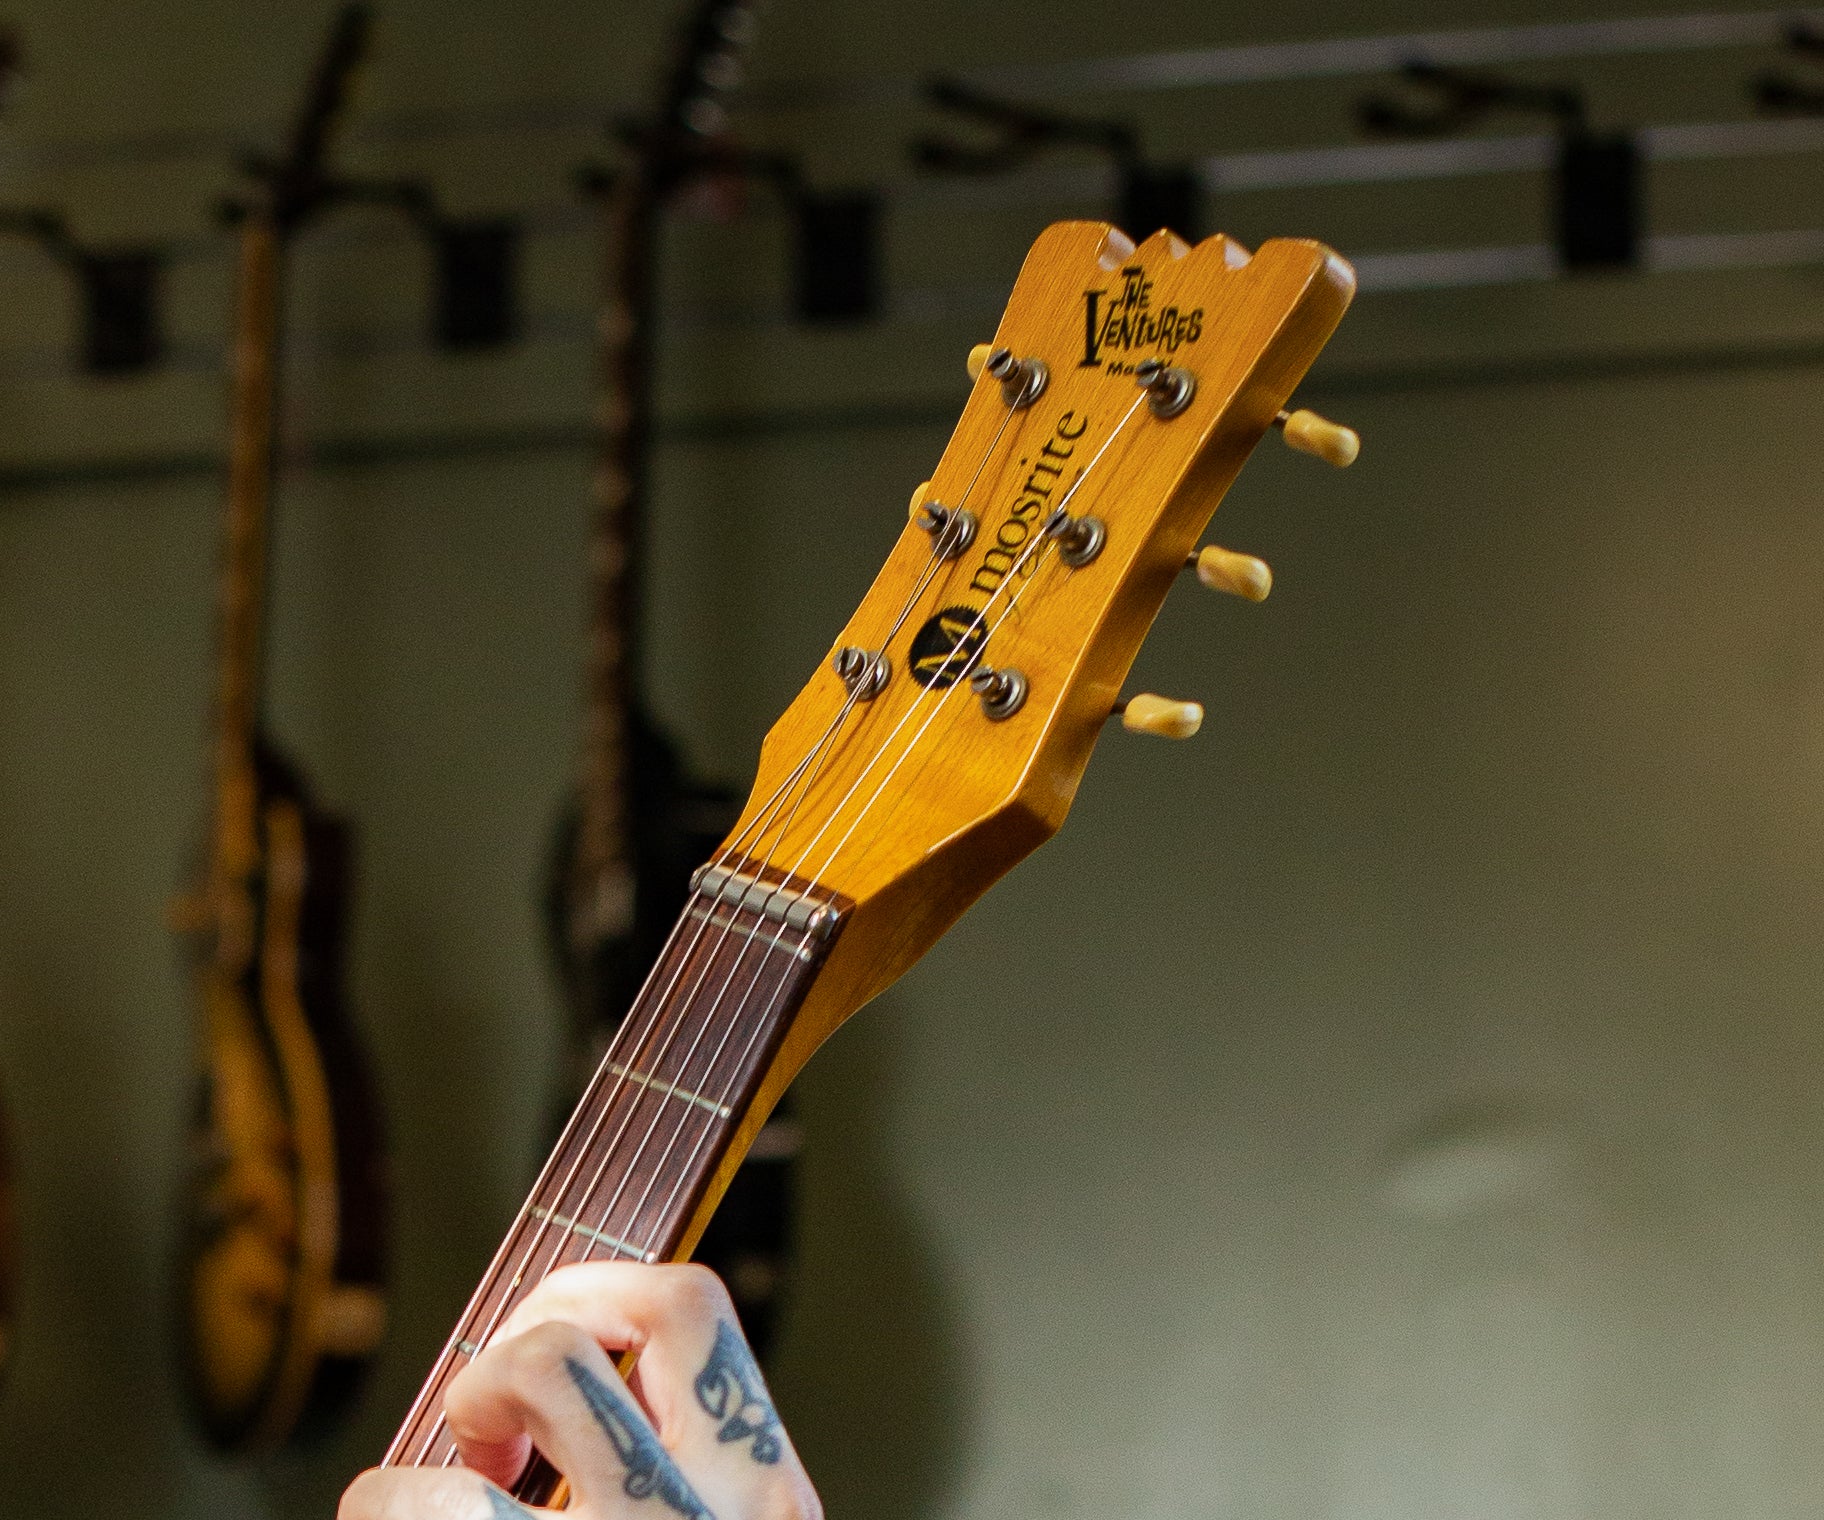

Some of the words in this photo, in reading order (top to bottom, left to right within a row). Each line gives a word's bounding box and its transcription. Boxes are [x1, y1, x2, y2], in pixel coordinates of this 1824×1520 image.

[1121, 265, 1154, 311] THE
[1078, 289, 1204, 367] VENTURES
[969, 410, 1089, 596] mosrite
